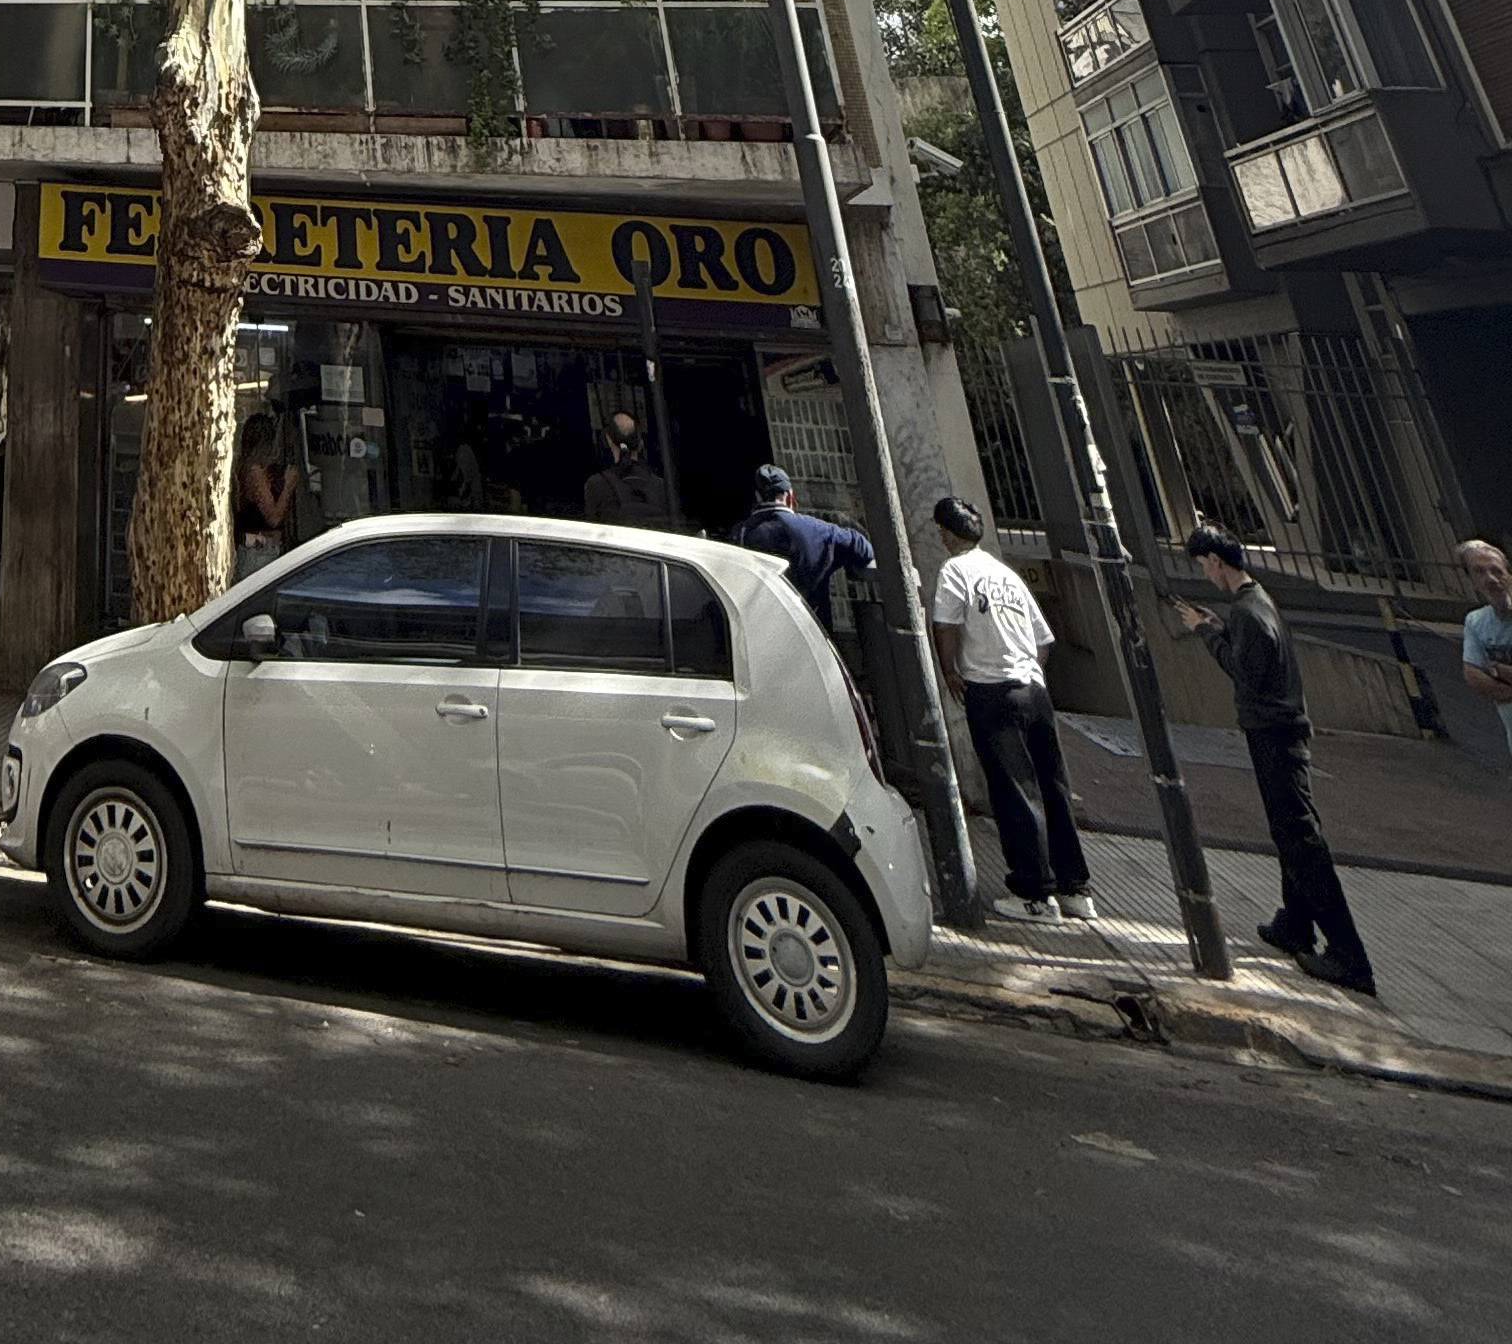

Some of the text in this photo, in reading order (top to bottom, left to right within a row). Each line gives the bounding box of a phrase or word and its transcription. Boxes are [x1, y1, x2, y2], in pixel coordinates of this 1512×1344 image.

[59, 189, 796, 296] FEETERIA ORO
[244, 272, 419, 305] ECTRICIDAD
[447, 285, 623, 317] SANITARIOS
